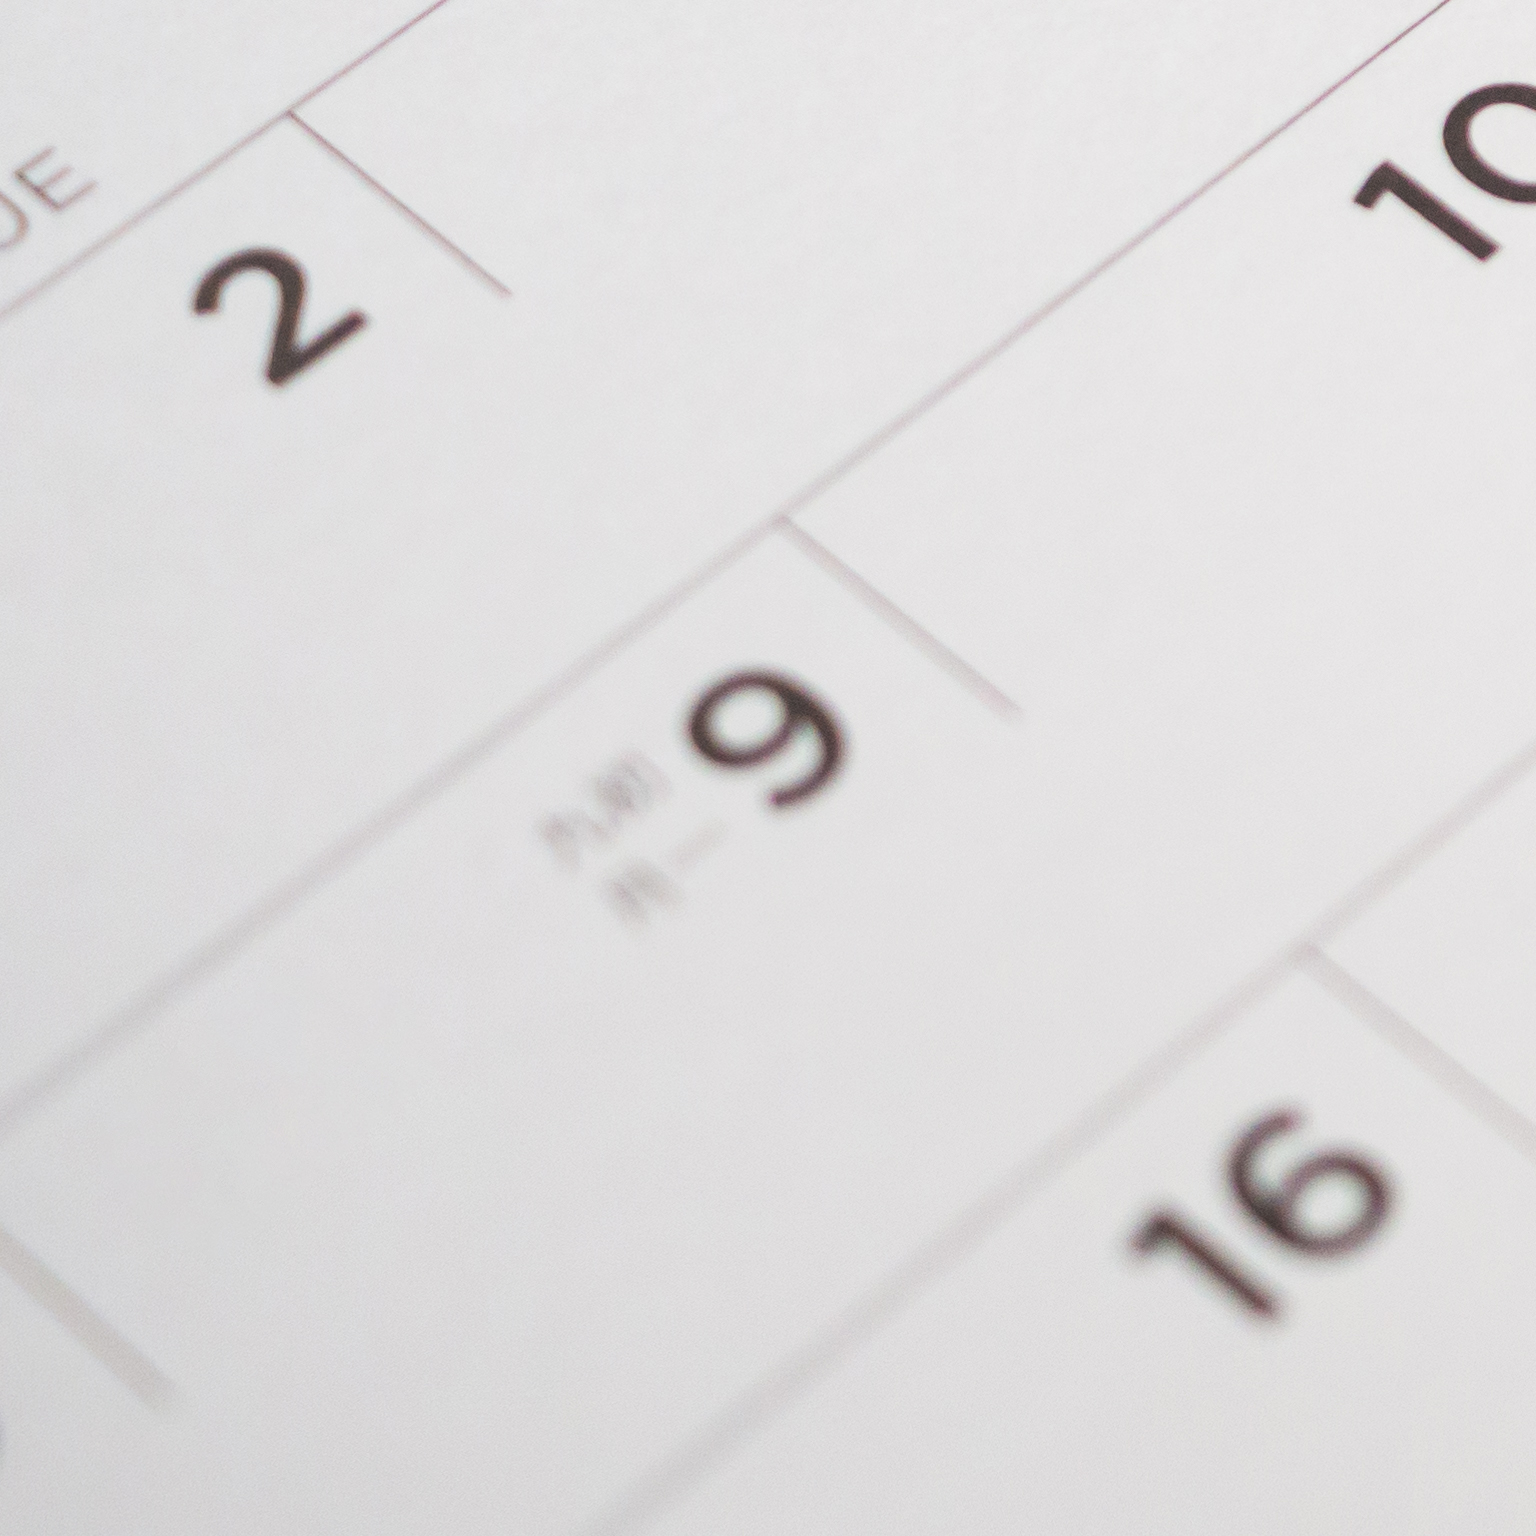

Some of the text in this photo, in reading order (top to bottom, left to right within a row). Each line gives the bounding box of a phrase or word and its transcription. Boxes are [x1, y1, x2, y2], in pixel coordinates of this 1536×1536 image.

[190, 246, 368, 389] 2
[684, 669, 847, 811] 9
[1130, 1110, 1395, 1321] 16
